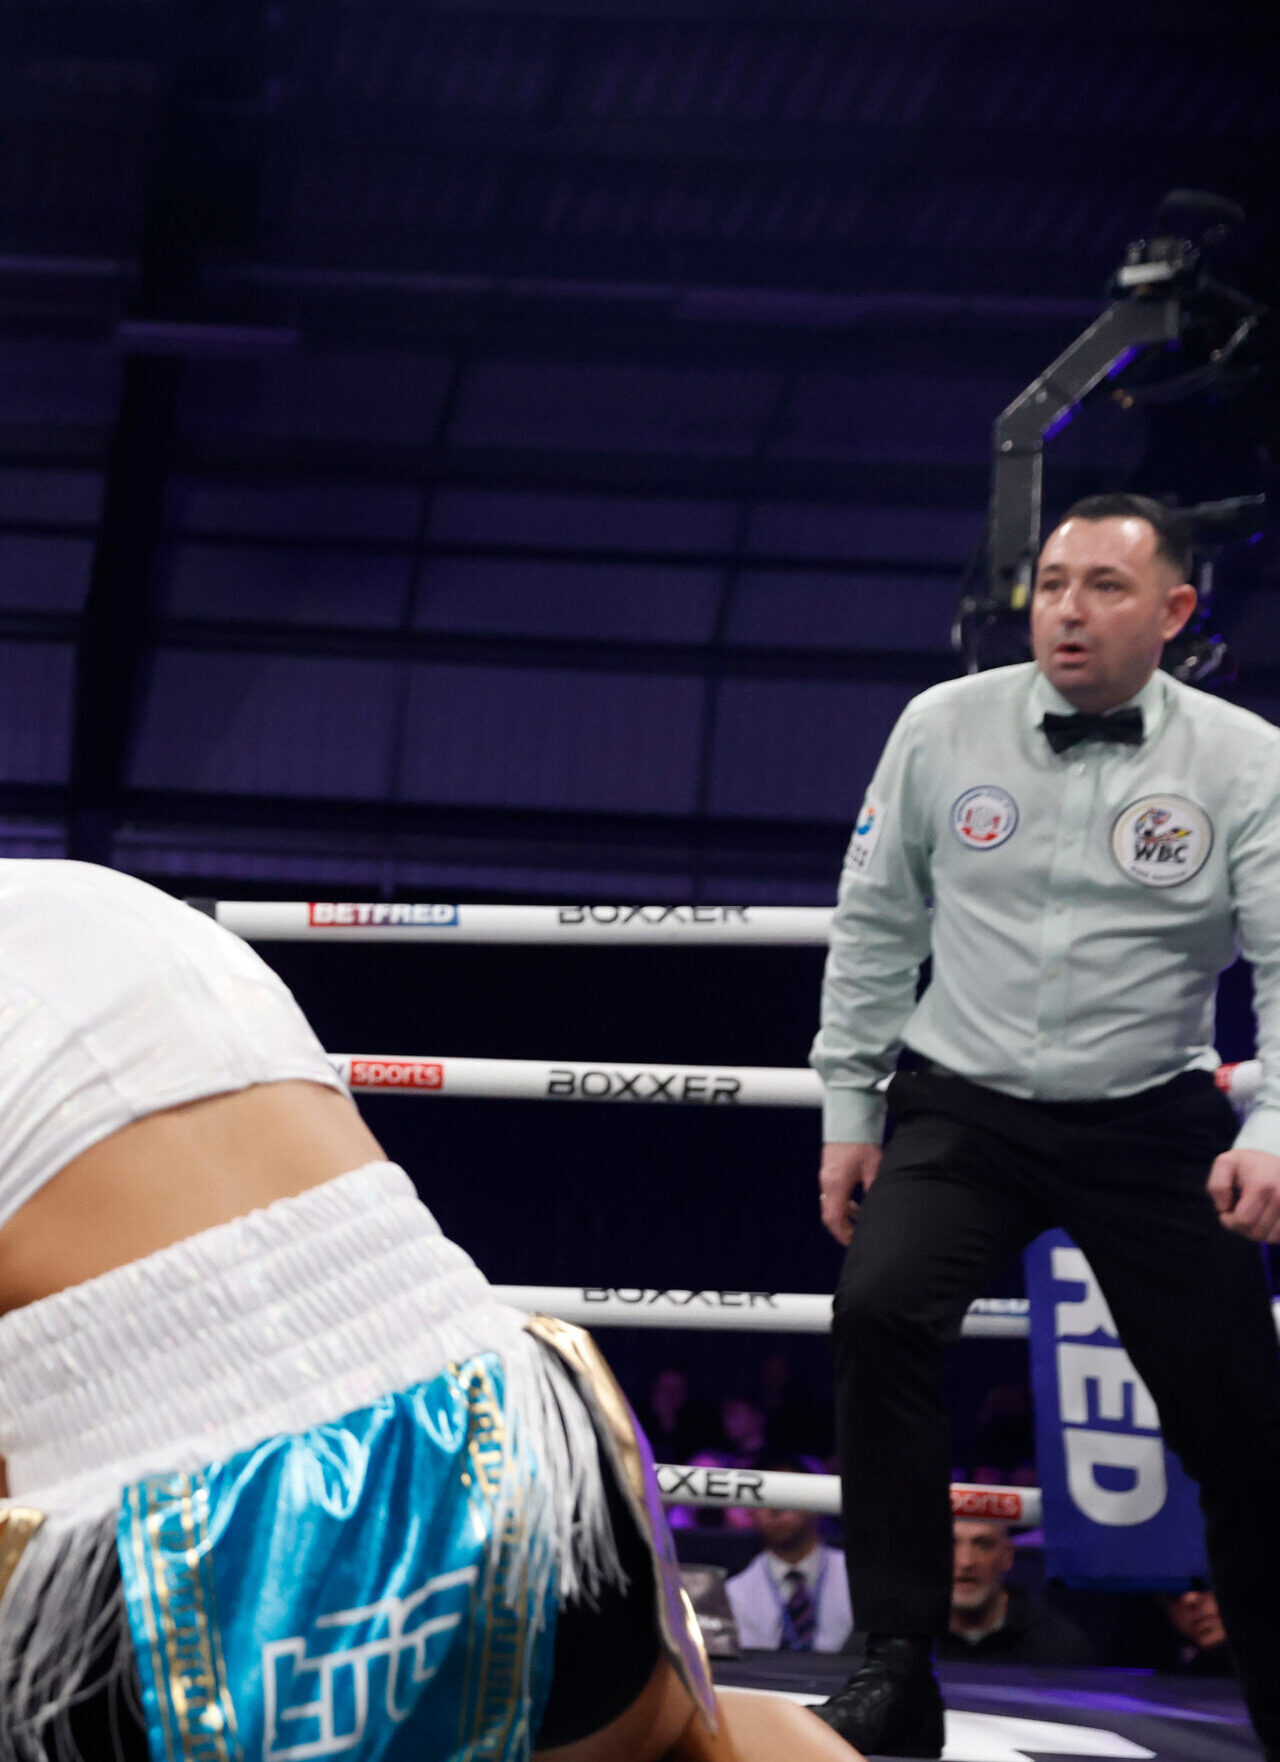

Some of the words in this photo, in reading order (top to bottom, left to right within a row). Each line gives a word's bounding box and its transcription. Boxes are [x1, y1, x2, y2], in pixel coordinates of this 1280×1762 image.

[1134, 842, 1188, 865] WBC
[312, 903, 455, 924] BETFRED
[352, 1062, 441, 1086] sports
[548, 1070, 743, 1102] BOXXER
